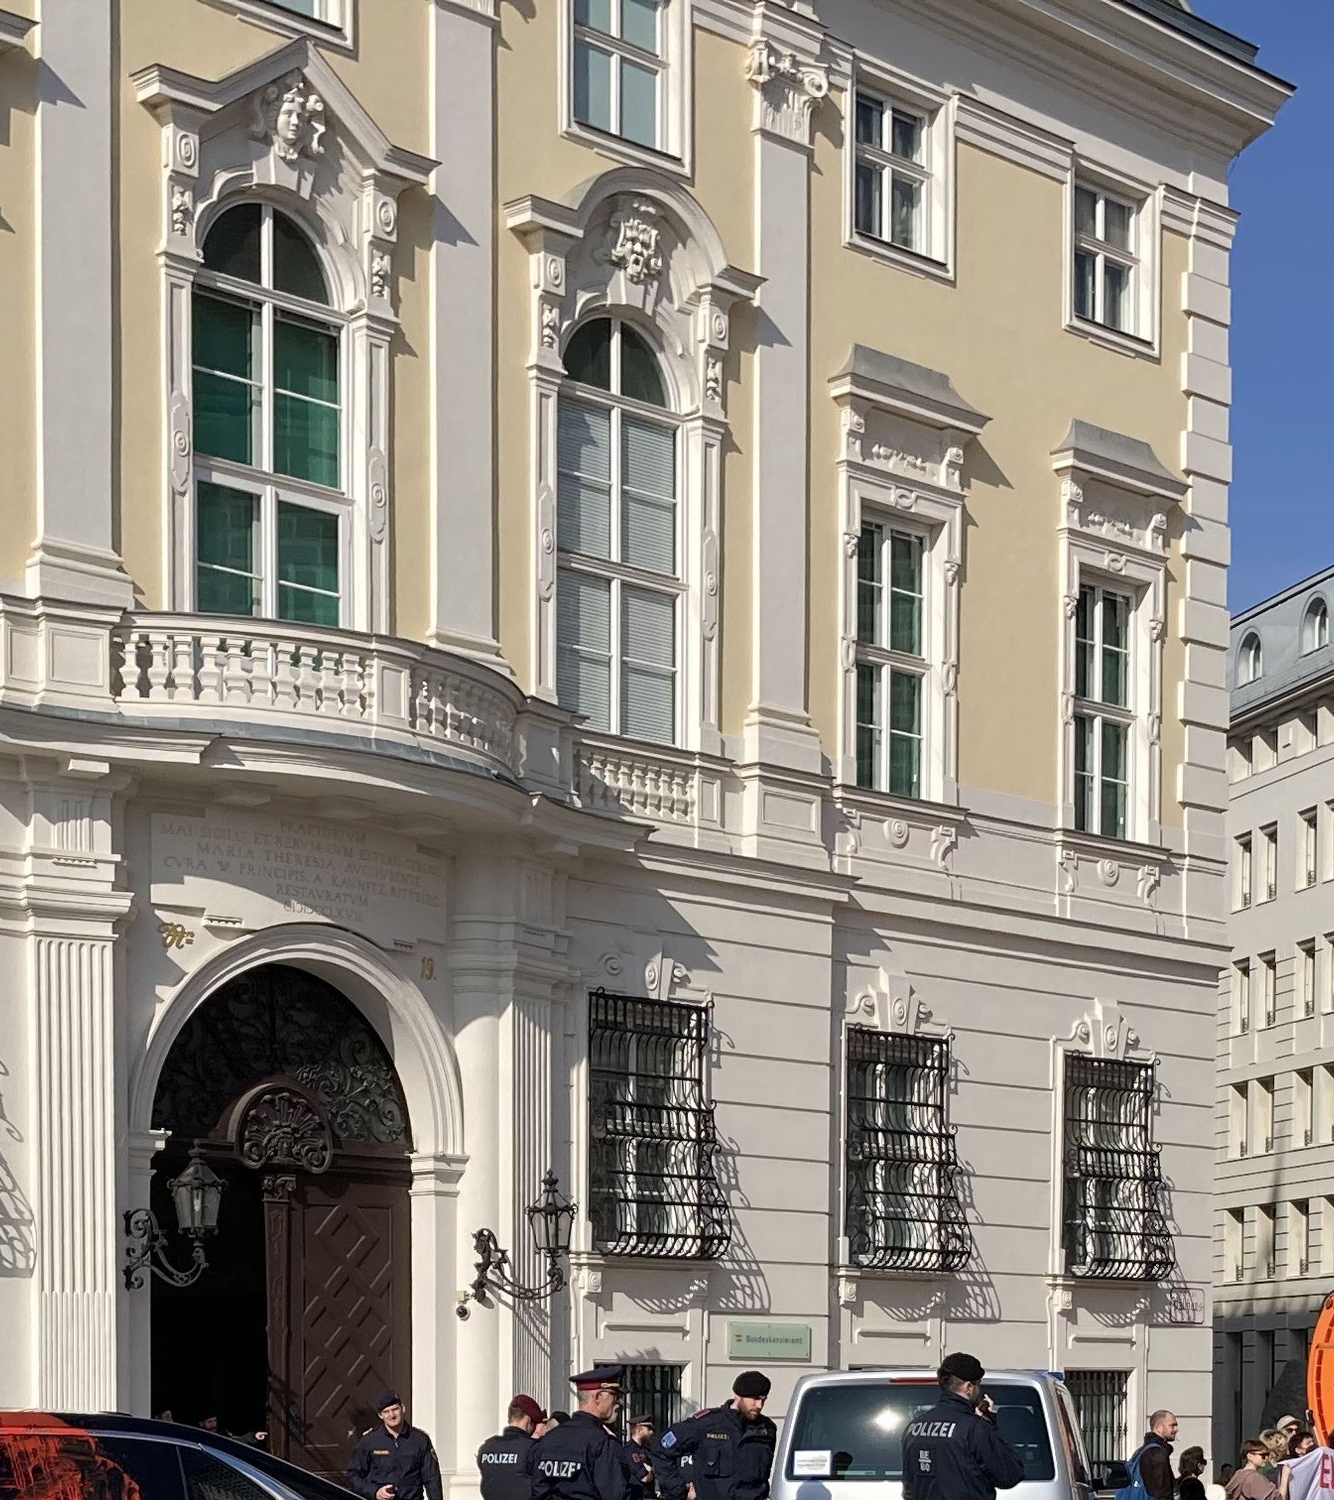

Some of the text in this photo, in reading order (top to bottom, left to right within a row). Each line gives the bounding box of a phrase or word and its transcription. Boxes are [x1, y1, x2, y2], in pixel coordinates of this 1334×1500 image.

[196, 842, 255, 859] MARIA
[164, 856, 207, 871] CVRA
[906, 1421, 957, 1438] POLIZEI
[480, 1452, 518, 1465] POLIZEI
